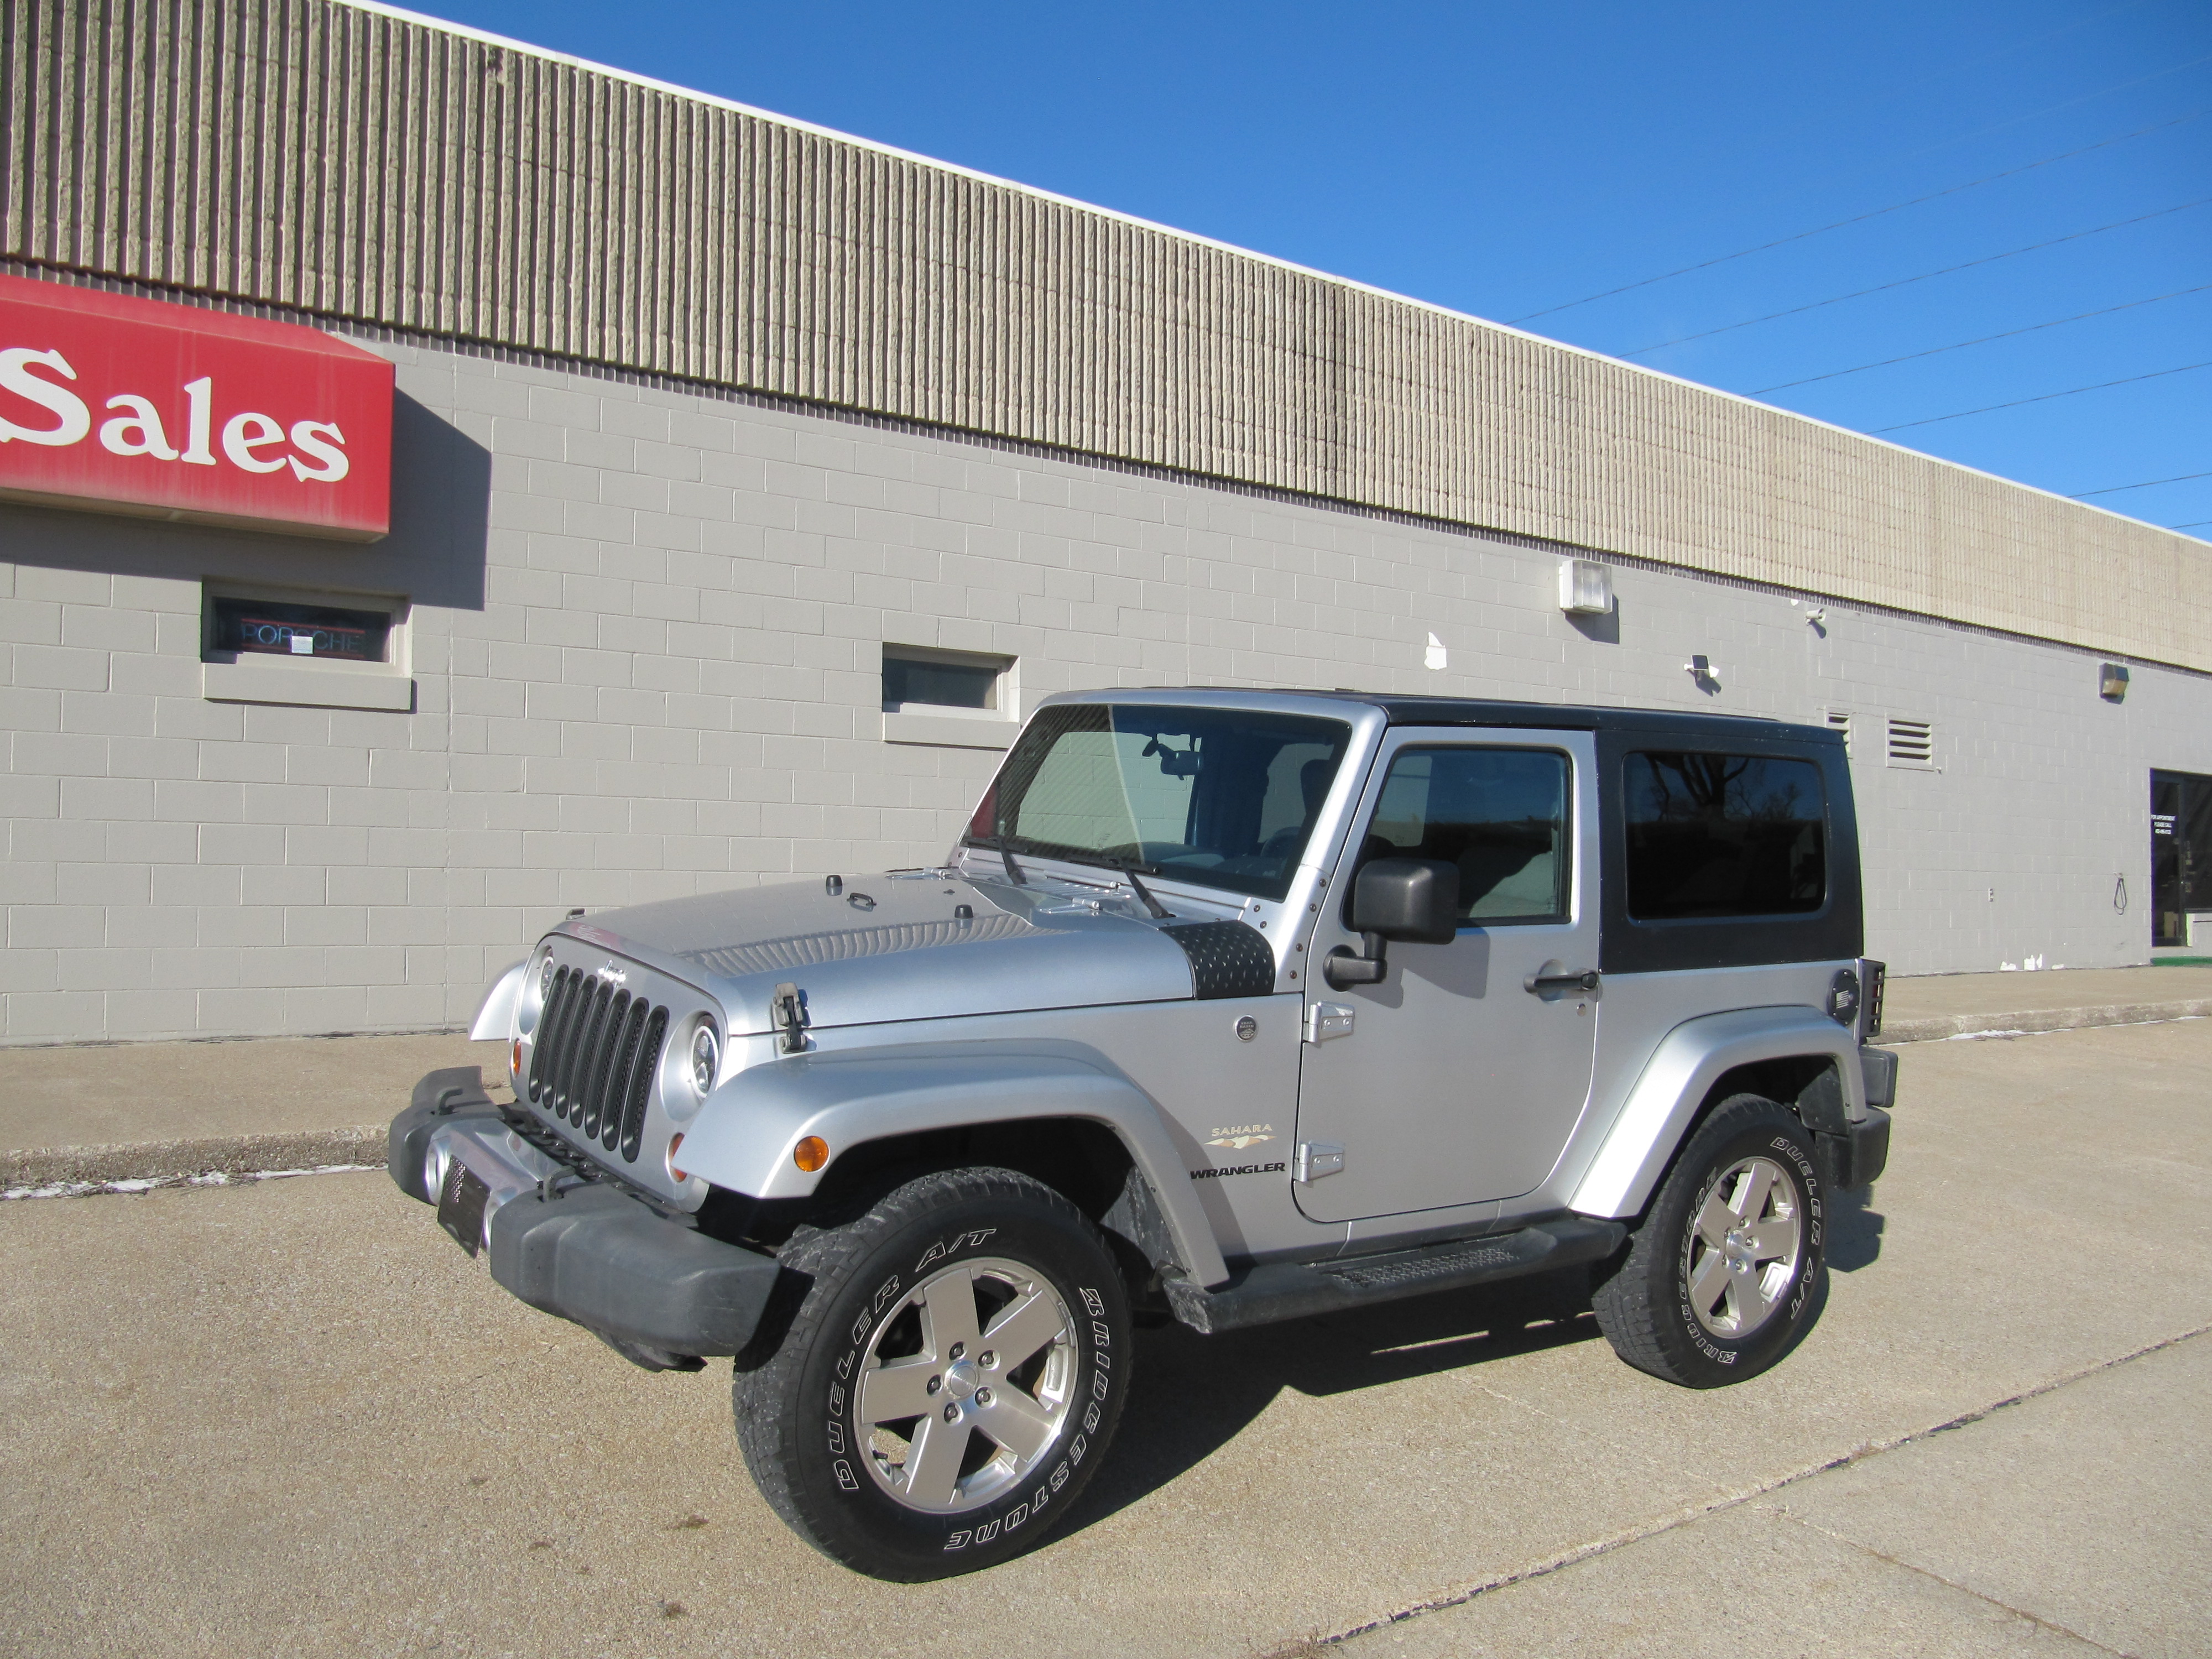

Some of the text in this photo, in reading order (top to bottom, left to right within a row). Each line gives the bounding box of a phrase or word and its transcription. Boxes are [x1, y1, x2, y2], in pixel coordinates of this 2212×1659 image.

[0, 348, 350, 483] Sales
[1190, 1162, 1286, 1180] WRANGLER
[1211, 1123, 1272, 1137] SAHARA
[1770, 1136, 1821, 1320] DUELER A/T
[828, 1228, 997, 1492] DUELER A/T
[943, 1287, 1112, 1550] BRIDGESTONE
